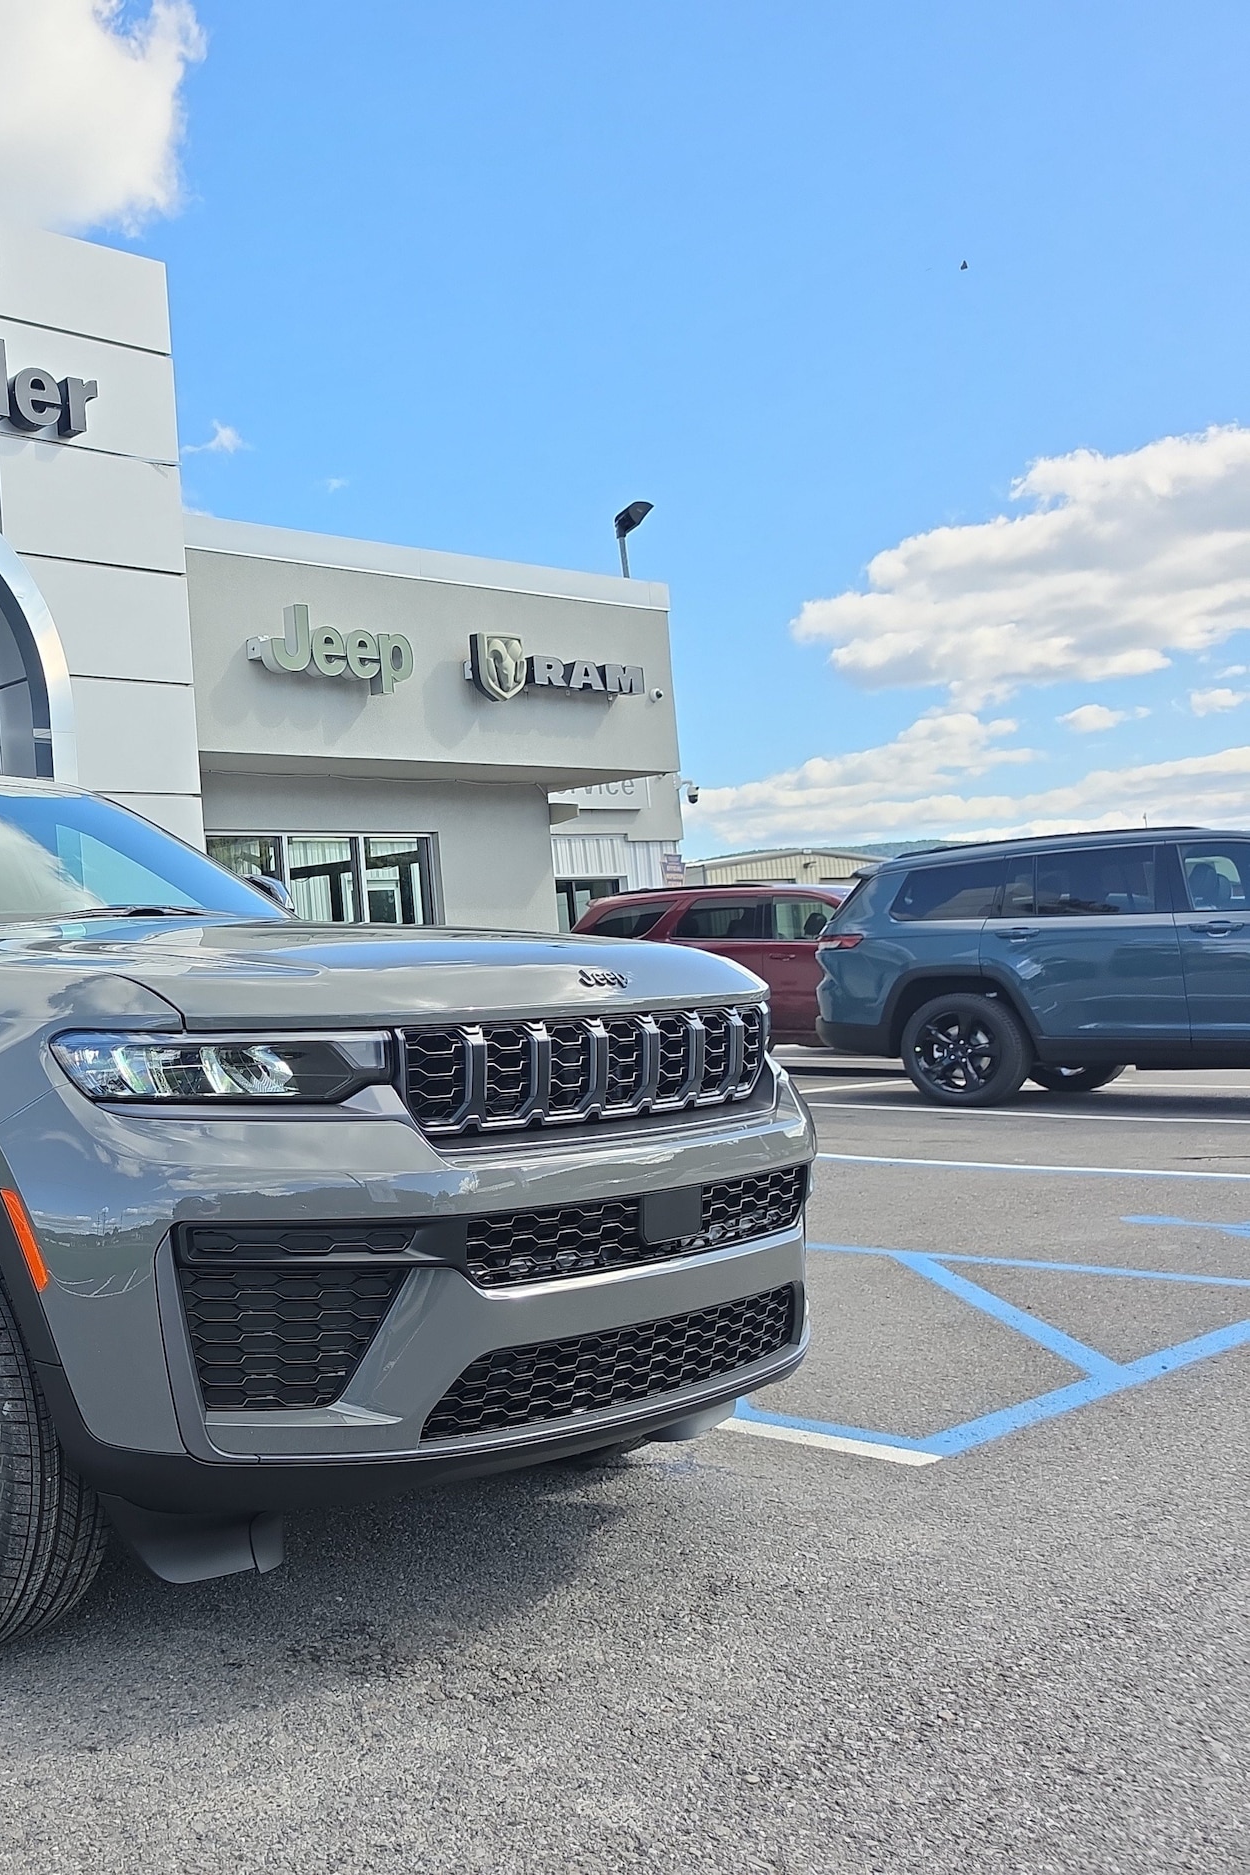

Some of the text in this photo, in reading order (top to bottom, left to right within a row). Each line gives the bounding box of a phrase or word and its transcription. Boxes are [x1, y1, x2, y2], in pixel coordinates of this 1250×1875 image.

[262, 604, 414, 695] Jeep
[529, 655, 645, 695] RAM
[578, 969, 628, 988] Jeep
